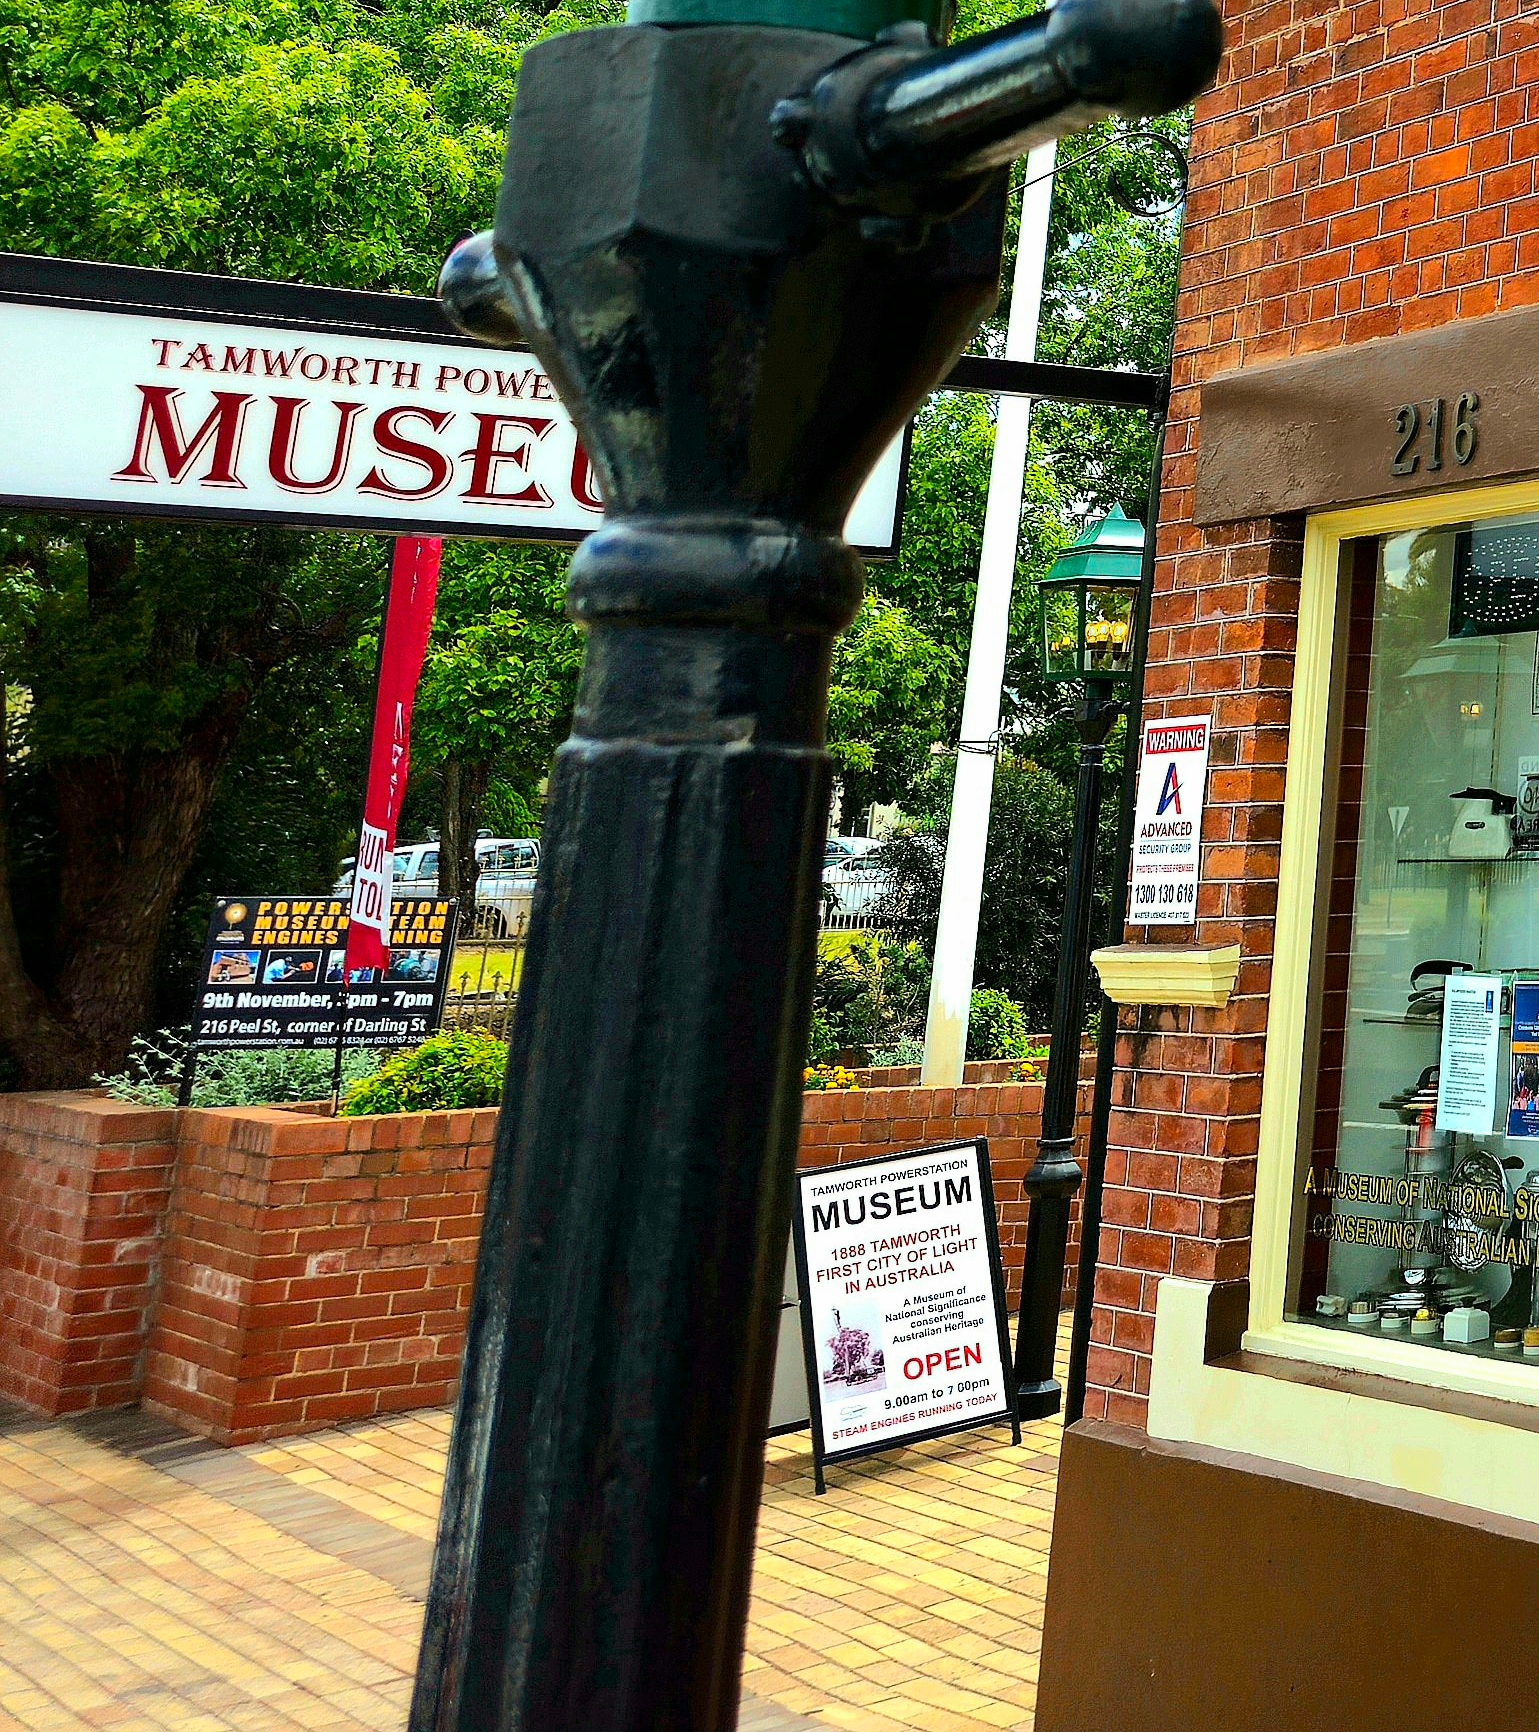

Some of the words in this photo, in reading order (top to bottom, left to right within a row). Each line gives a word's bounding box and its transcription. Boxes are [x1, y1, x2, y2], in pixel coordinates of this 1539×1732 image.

[152, 338, 421, 390] TAMWORTH
[436, 365, 565, 402] POWE
[1390, 391, 1480, 477] 216
[1148, 728, 1205, 752] WARNING
[1140, 821, 1192, 838] ADVANCED
[1138, 845, 1169, 855] SECURITY
[1170, 843, 1191, 854] GROUP
[1135, 884, 1155, 904] 1300
[1158, 884, 1174, 904] 130
[1176, 884, 1194, 903] 618
[389, 915, 446, 930] TEAM
[251, 930, 338, 945] ENGINES
[202, 992, 235, 1008] 9th
[237, 991, 333, 1009] November,
[393, 990, 434, 1008] 7pm
[200, 1019, 228, 1033] 216
[228, 1018, 261, 1033] Peel
[262, 1018, 281, 1035] St,
[287, 1021, 335, 1033] corner
[354, 1017, 408, 1035] Darling
[410, 1017, 427, 1031] St
[811, 1177, 877, 1197] TAMWORTH
[881, 1159, 968, 1184] POWERSTATION
[1303, 1165, 1317, 1196] A
[1323, 1166, 1394, 1206] MUSEUM
[1396, 1179, 1420, 1207] OF
[1422, 1175, 1511, 1219] NATIONAL
[812, 1175, 972, 1233] MUSEUM
[831, 1243, 866, 1261] 1888
[870, 1224, 961, 1254] TAMWORTH
[1313, 1212, 1416, 1252] CONSERVING
[1416, 1219, 1531, 1266] AUSTRALIAN
[816, 1261, 861, 1283] FIRST
[867, 1253, 902, 1272] CITY
[907, 1247, 928, 1263] OF
[933, 1237, 978, 1258] LIGHT
[845, 1280, 860, 1294] IN
[865, 1260, 955, 1290] AUSTRALIA
[885, 1306, 925, 1323] National
[927, 1293, 986, 1313] Significance
[903, 1298, 911, 1307] A
[913, 1289, 954, 1305] Museum
[956, 1285, 967, 1295] of
[892, 1326, 942, 1344] Australian
[944, 1317, 984, 1333] Heritage
[910, 1310, 964, 1329] conserving
[903, 1342, 982, 1381] OPEN
[884, 1391, 928, 1410] 9.00am
[932, 1388, 944, 1399] to
[832, 1424, 868, 1440] STEAM
[870, 1412, 916, 1431] ENGINES
[918, 1401, 963, 1419] RUNNING
[966, 1392, 998, 1407] TODAY
